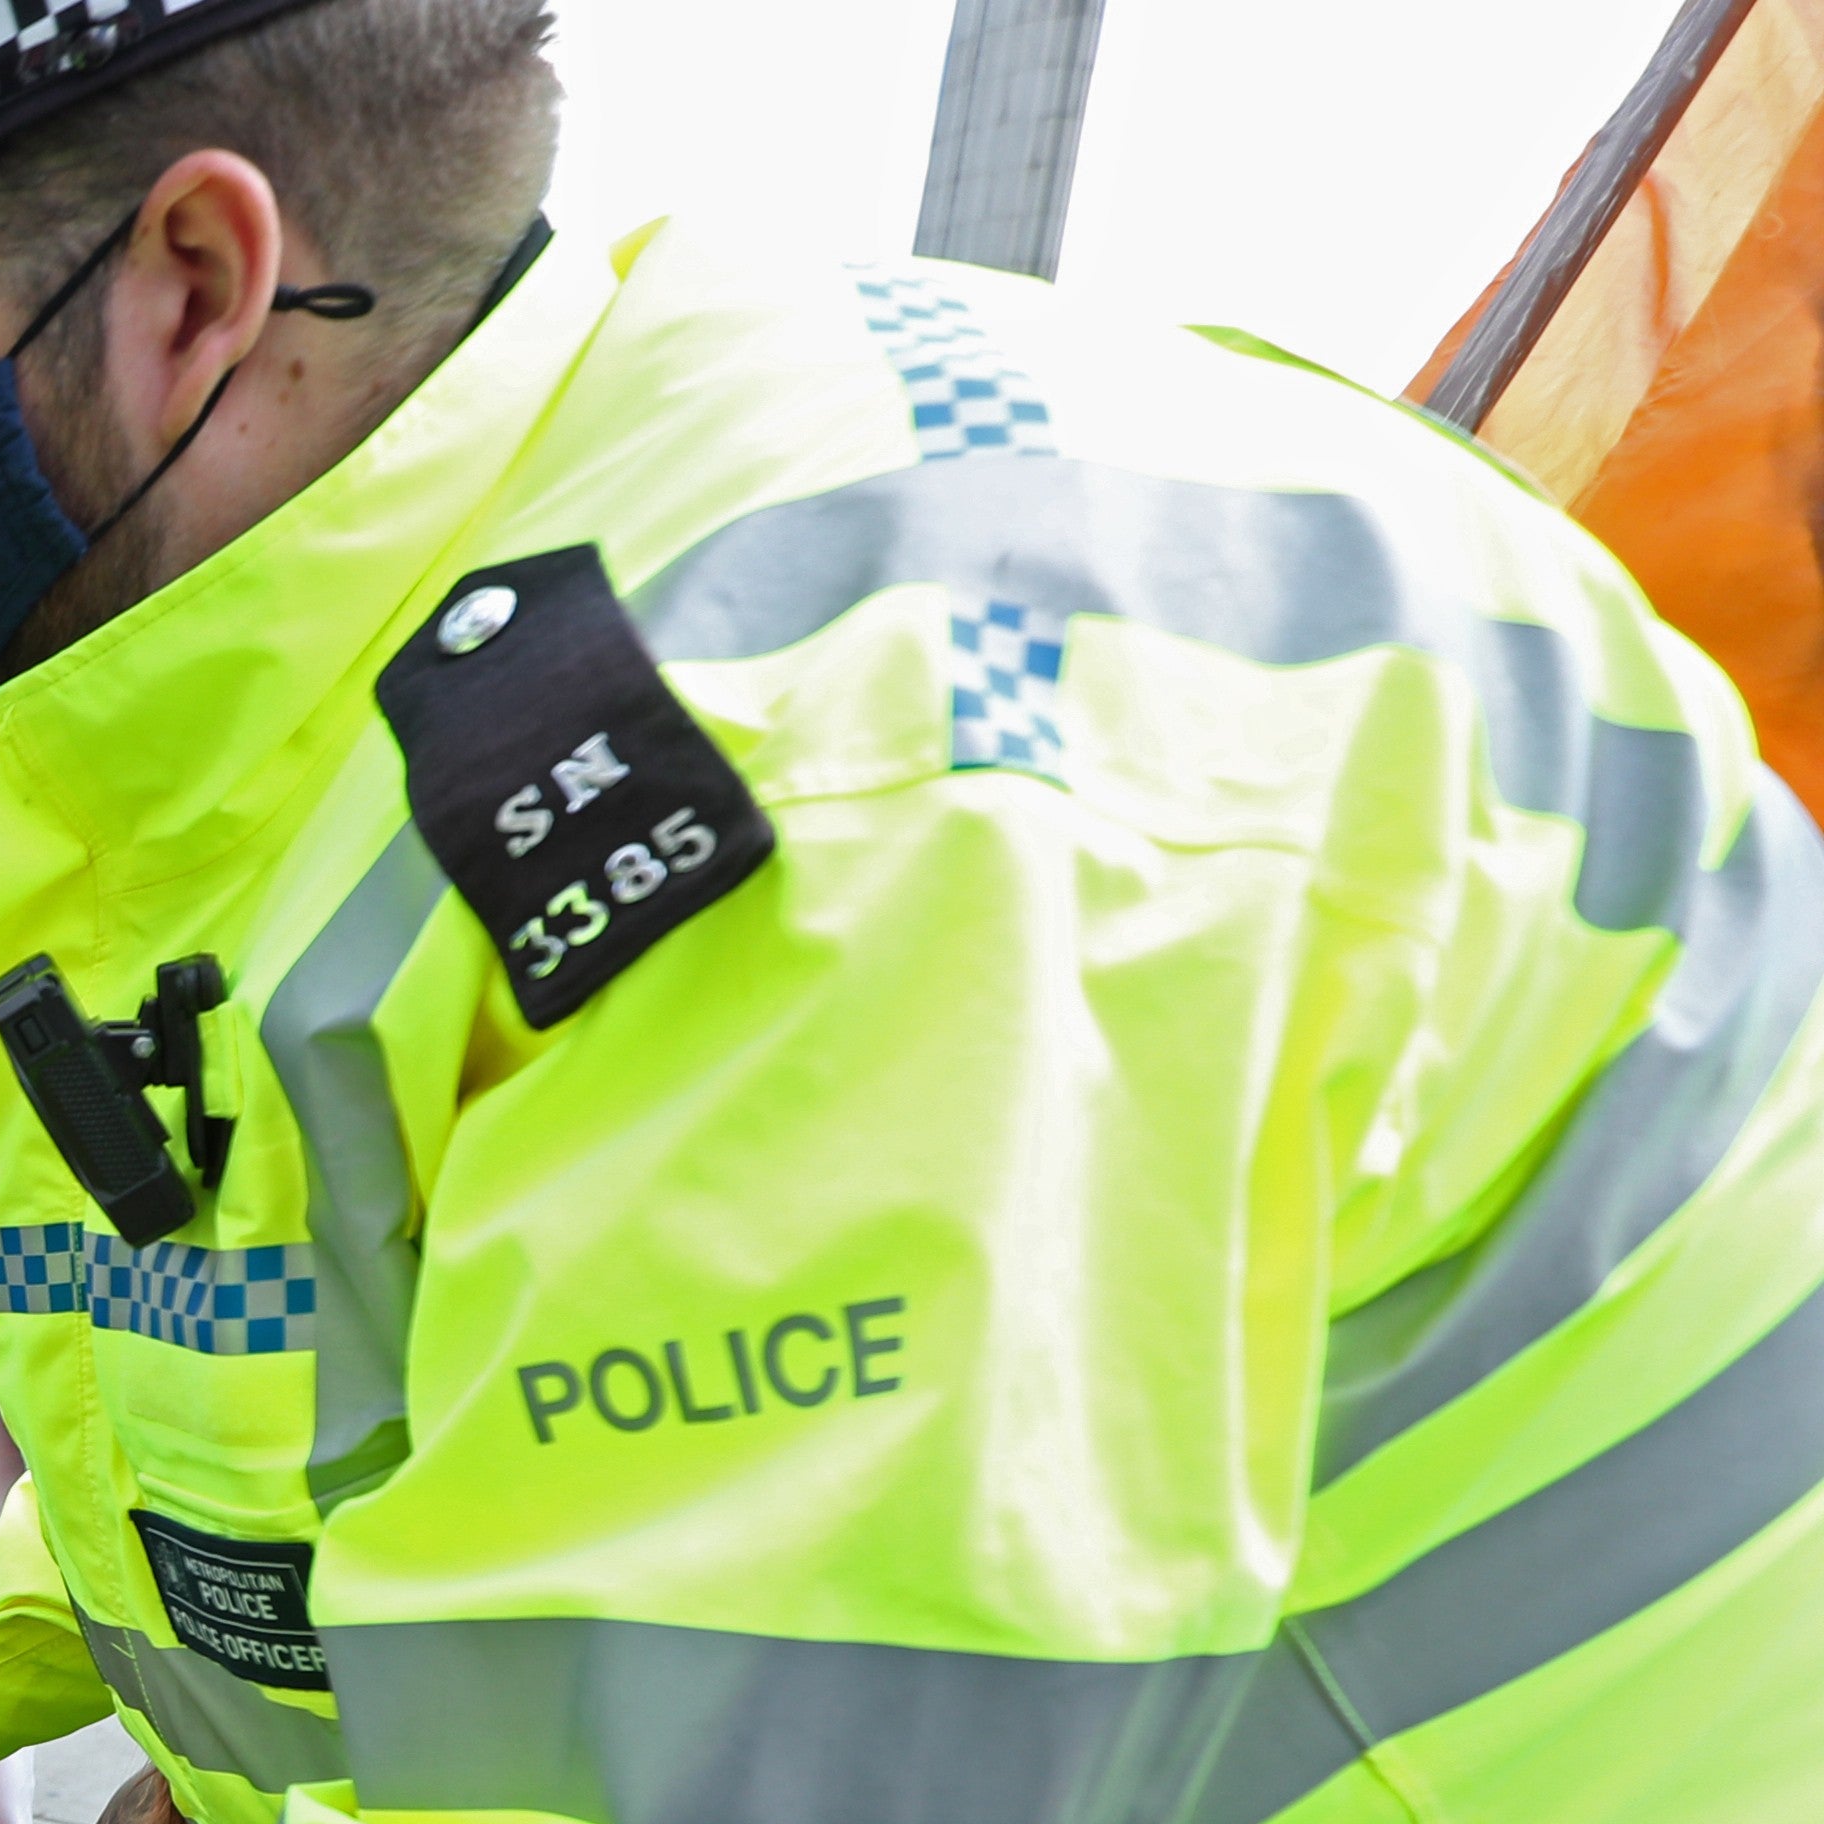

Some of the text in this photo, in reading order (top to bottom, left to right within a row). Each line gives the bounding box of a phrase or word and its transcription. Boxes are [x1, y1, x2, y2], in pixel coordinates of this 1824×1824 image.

[509, 806, 718, 980] 3385
[516, 1297, 906, 1445] POLICE
[183, 1555, 285, 1592] METROPOLITAN
[198, 1581, 279, 1620] POLICE
[170, 1605, 225, 1654] POLICE
